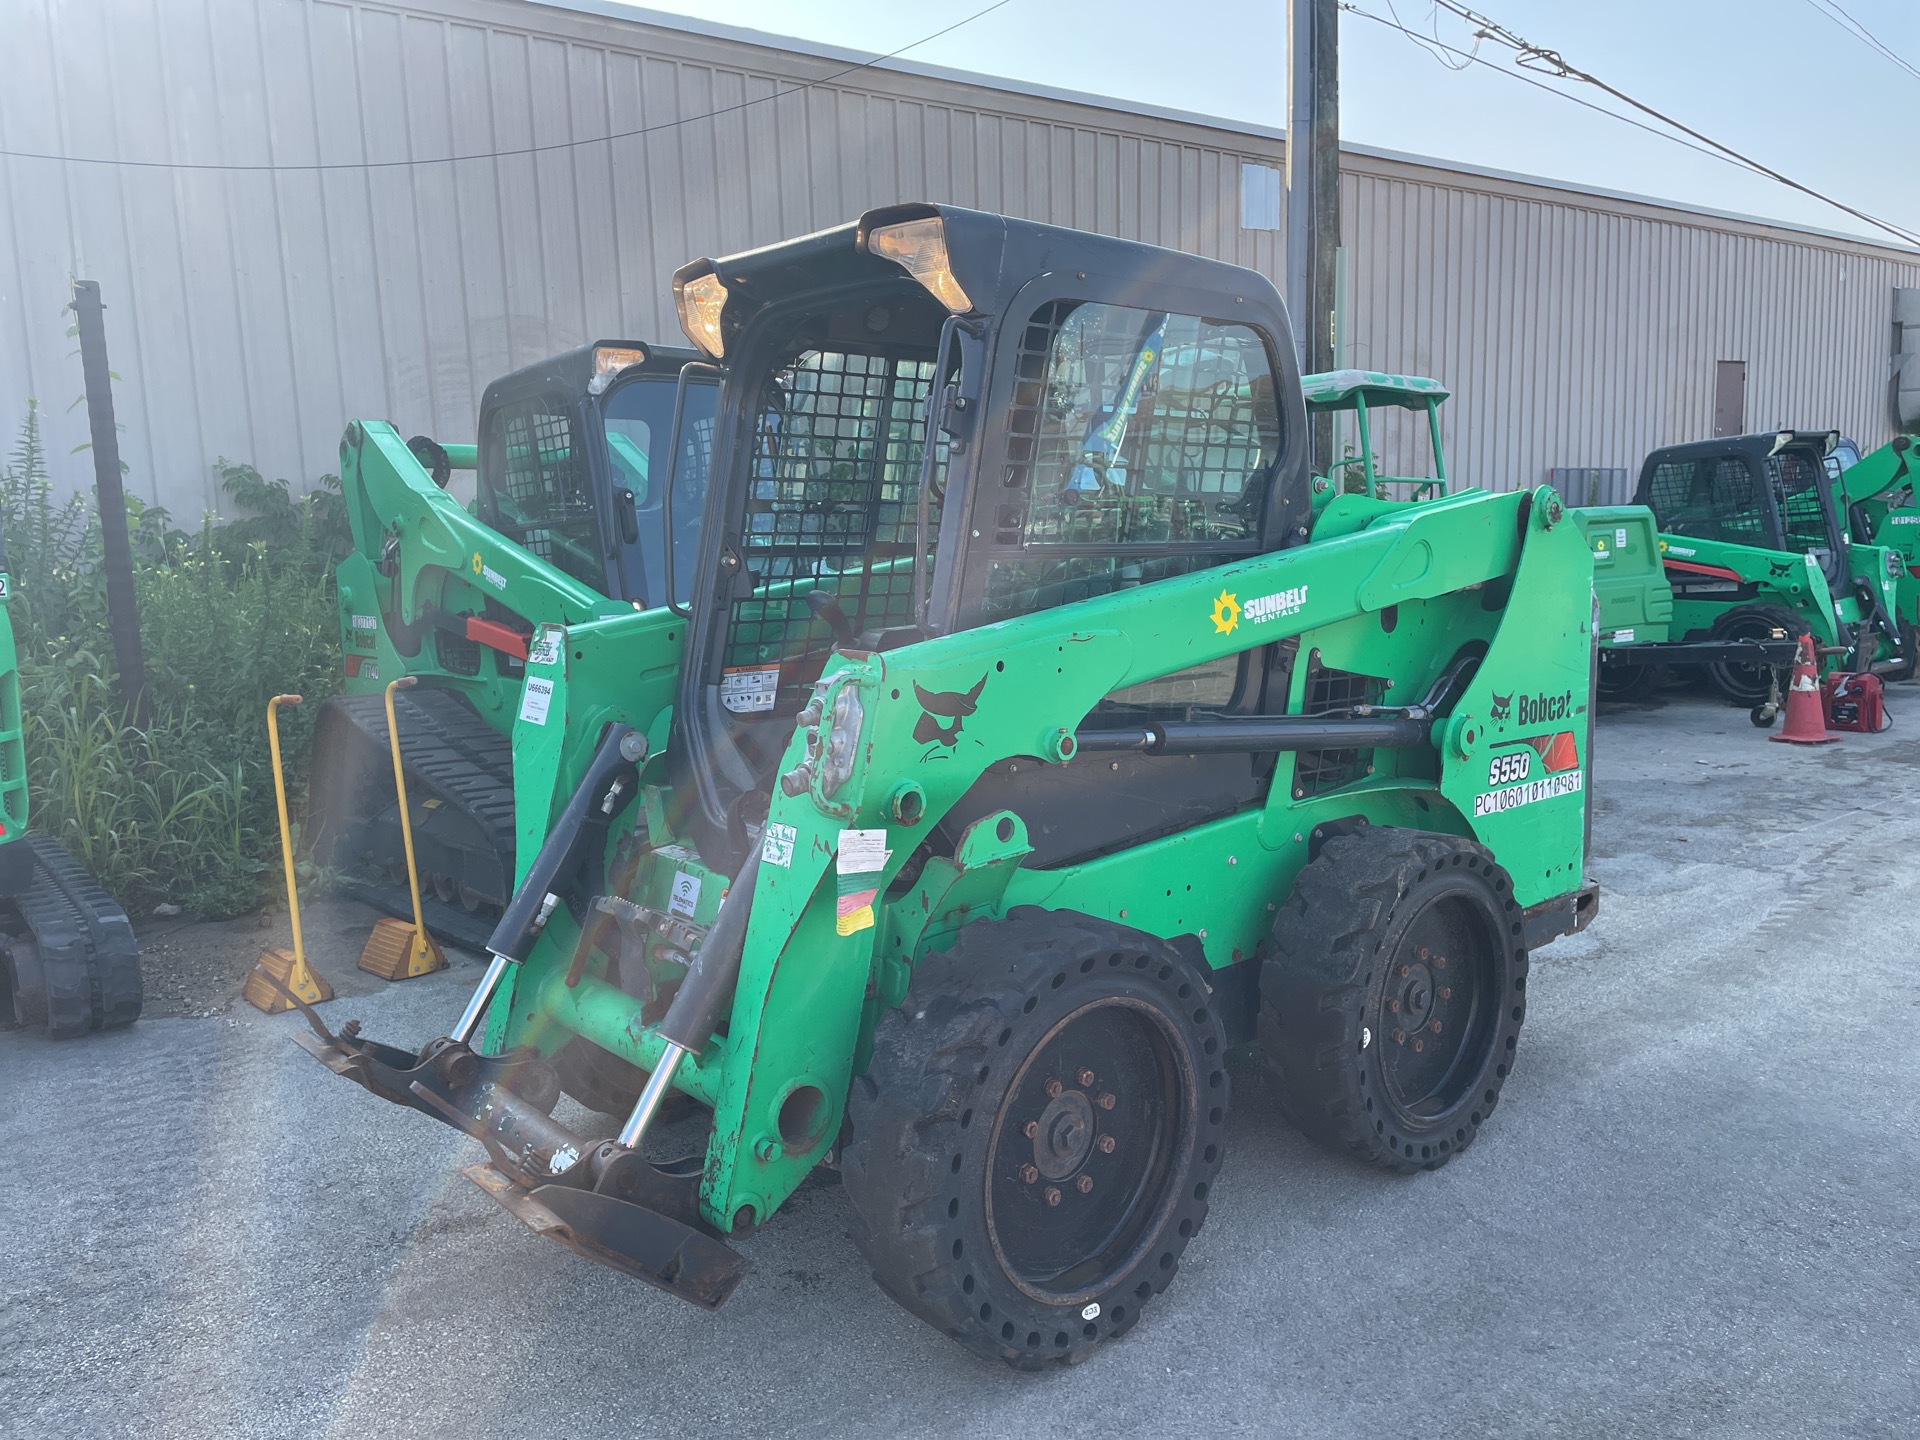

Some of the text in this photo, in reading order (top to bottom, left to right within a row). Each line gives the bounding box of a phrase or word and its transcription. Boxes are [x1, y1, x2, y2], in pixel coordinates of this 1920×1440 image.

[1243, 585, 1308, 620] SUNBELT
[1254, 606, 1300, 625] RENTALS
[355, 630, 377, 650] Bobcat
[527, 682, 551, 696] U666394
[1518, 690, 1571, 726] Bobcat
[1488, 750, 1531, 787] S550
[673, 893, 694, 908] TELEMATICS
[1084, 1305, 1098, 1316] ECR
